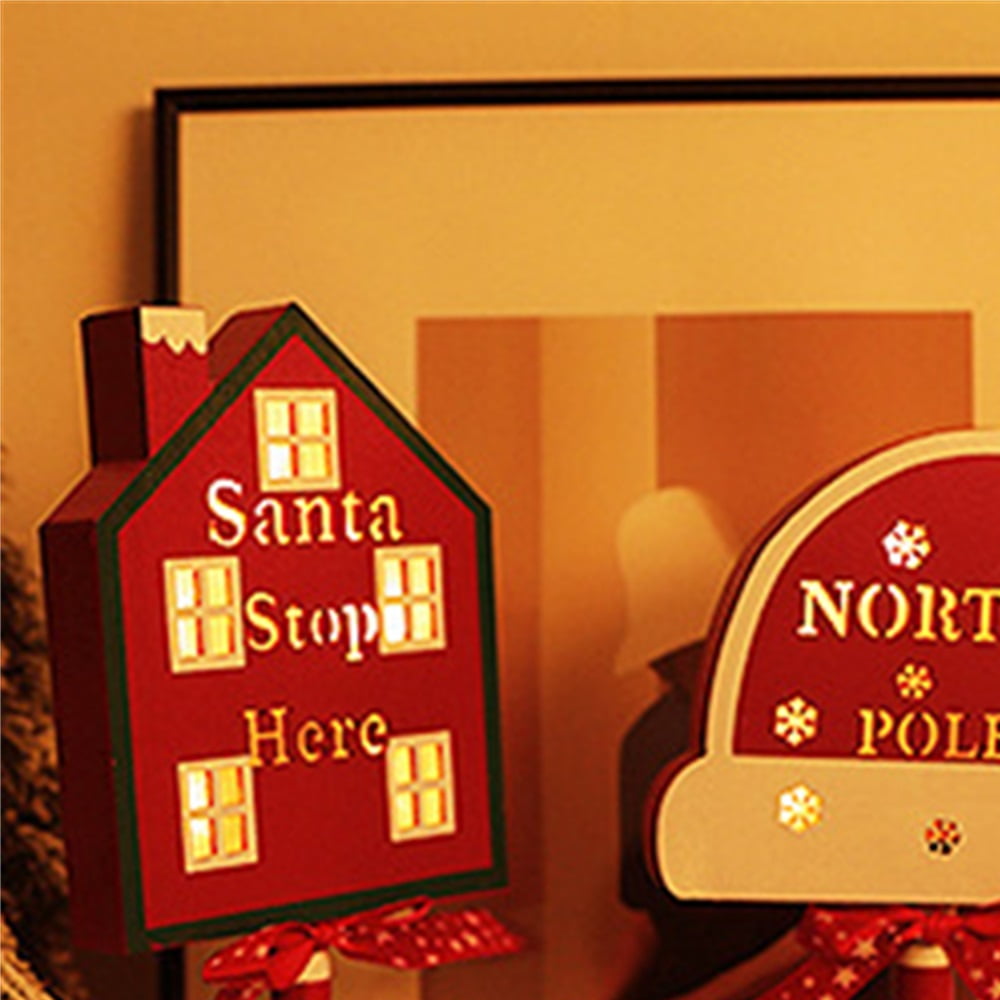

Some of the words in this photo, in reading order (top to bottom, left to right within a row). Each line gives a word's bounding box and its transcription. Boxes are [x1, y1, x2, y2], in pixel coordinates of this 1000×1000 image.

[207, 478, 402, 547] Santa
[245, 592, 378, 662] Stop
[244, 706, 387, 767] Here
